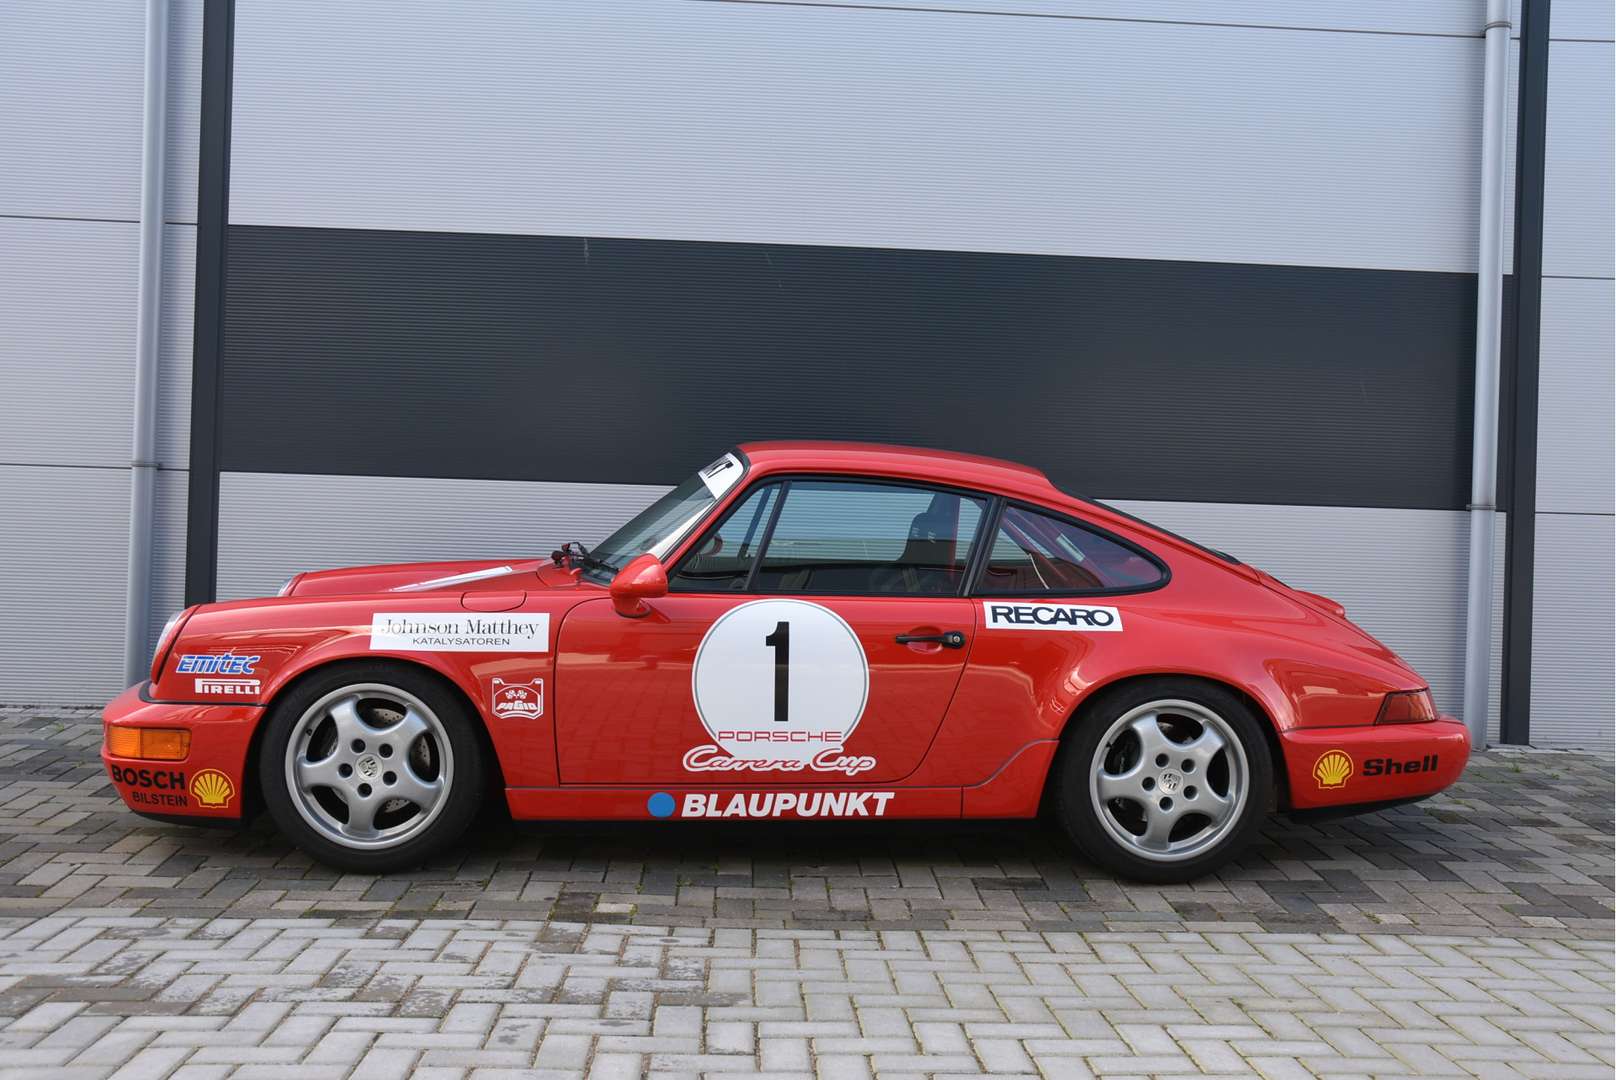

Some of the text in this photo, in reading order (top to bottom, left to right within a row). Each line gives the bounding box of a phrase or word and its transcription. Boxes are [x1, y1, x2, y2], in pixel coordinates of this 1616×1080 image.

[991, 605, 1114, 627] RECARO
[381, 618, 539, 639] Johnson Matthey
[412, 637, 511, 646] KATALYSATOREN
[765, 621, 790, 721] 1
[195, 678, 261, 695] PIRELLI
[718, 731, 842, 742] PORSCHE
[683, 745, 877, 776] Carrera Cup
[1362, 754, 1438, 776] Shell
[111, 764, 186, 790] BOSCH
[132, 791, 188, 807] BILSTEIN
[681, 792, 895, 817] BLAUPUNKT
